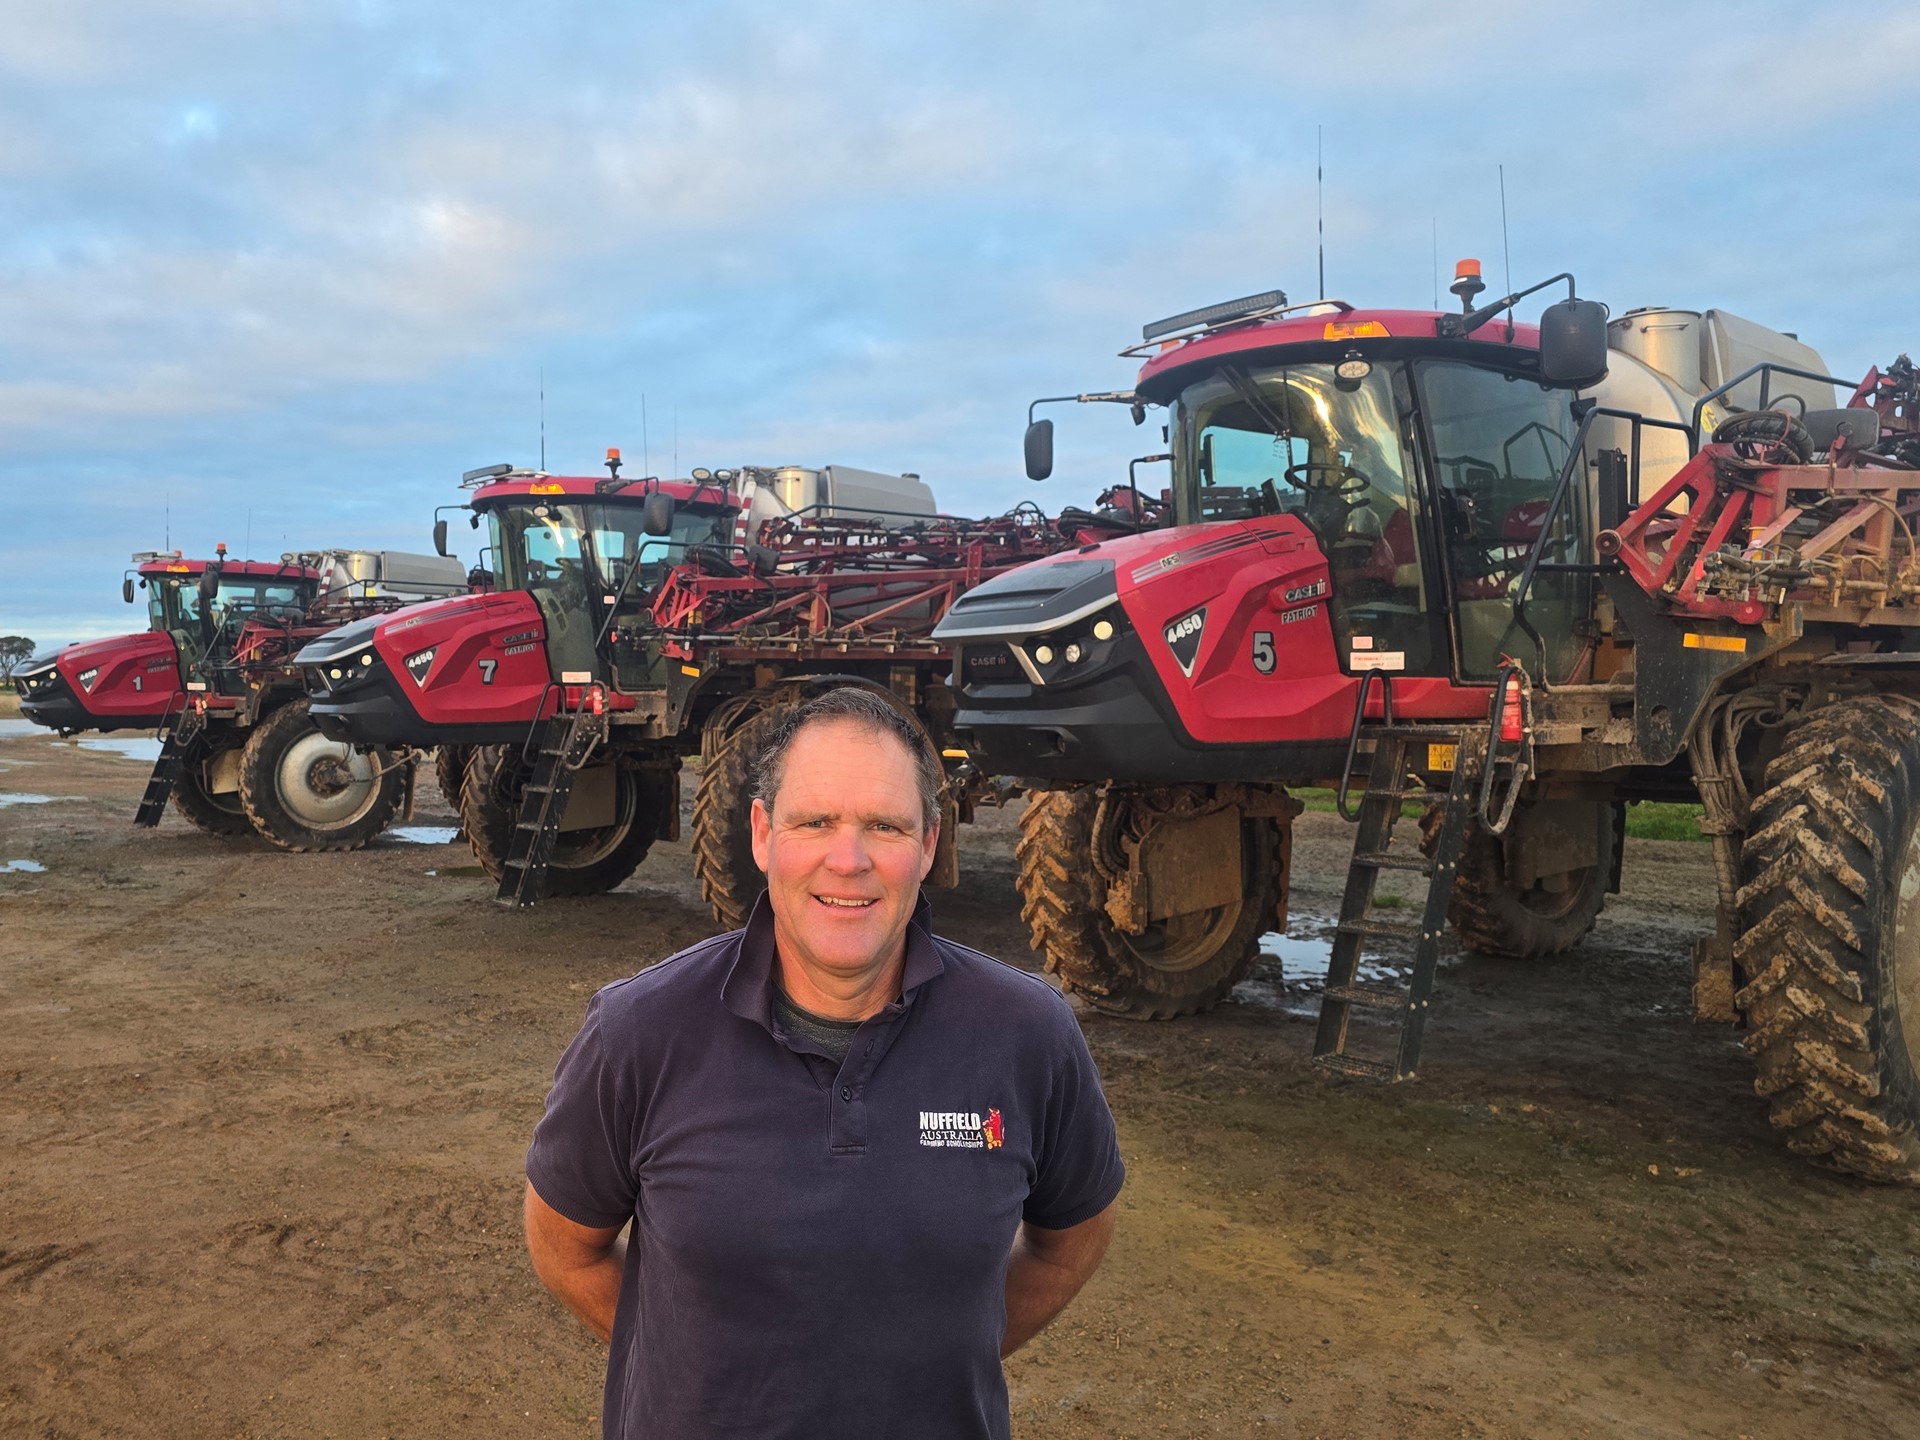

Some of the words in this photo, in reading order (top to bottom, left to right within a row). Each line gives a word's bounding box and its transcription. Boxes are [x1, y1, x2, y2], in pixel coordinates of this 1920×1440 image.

[1286, 585, 1317, 602] CASE
[1281, 604, 1318, 625] PATRIOT
[1167, 613, 1203, 644] 4450
[408, 651, 434, 668] 4450
[970, 656, 997, 666] CASE
[1252, 631, 1277, 674] 5
[478, 659, 498, 685] 7
[132, 675, 142, 691] 1
[919, 1111, 981, 1130] NUFFIELD
[920, 1130, 983, 1141] AUSTRALIA
